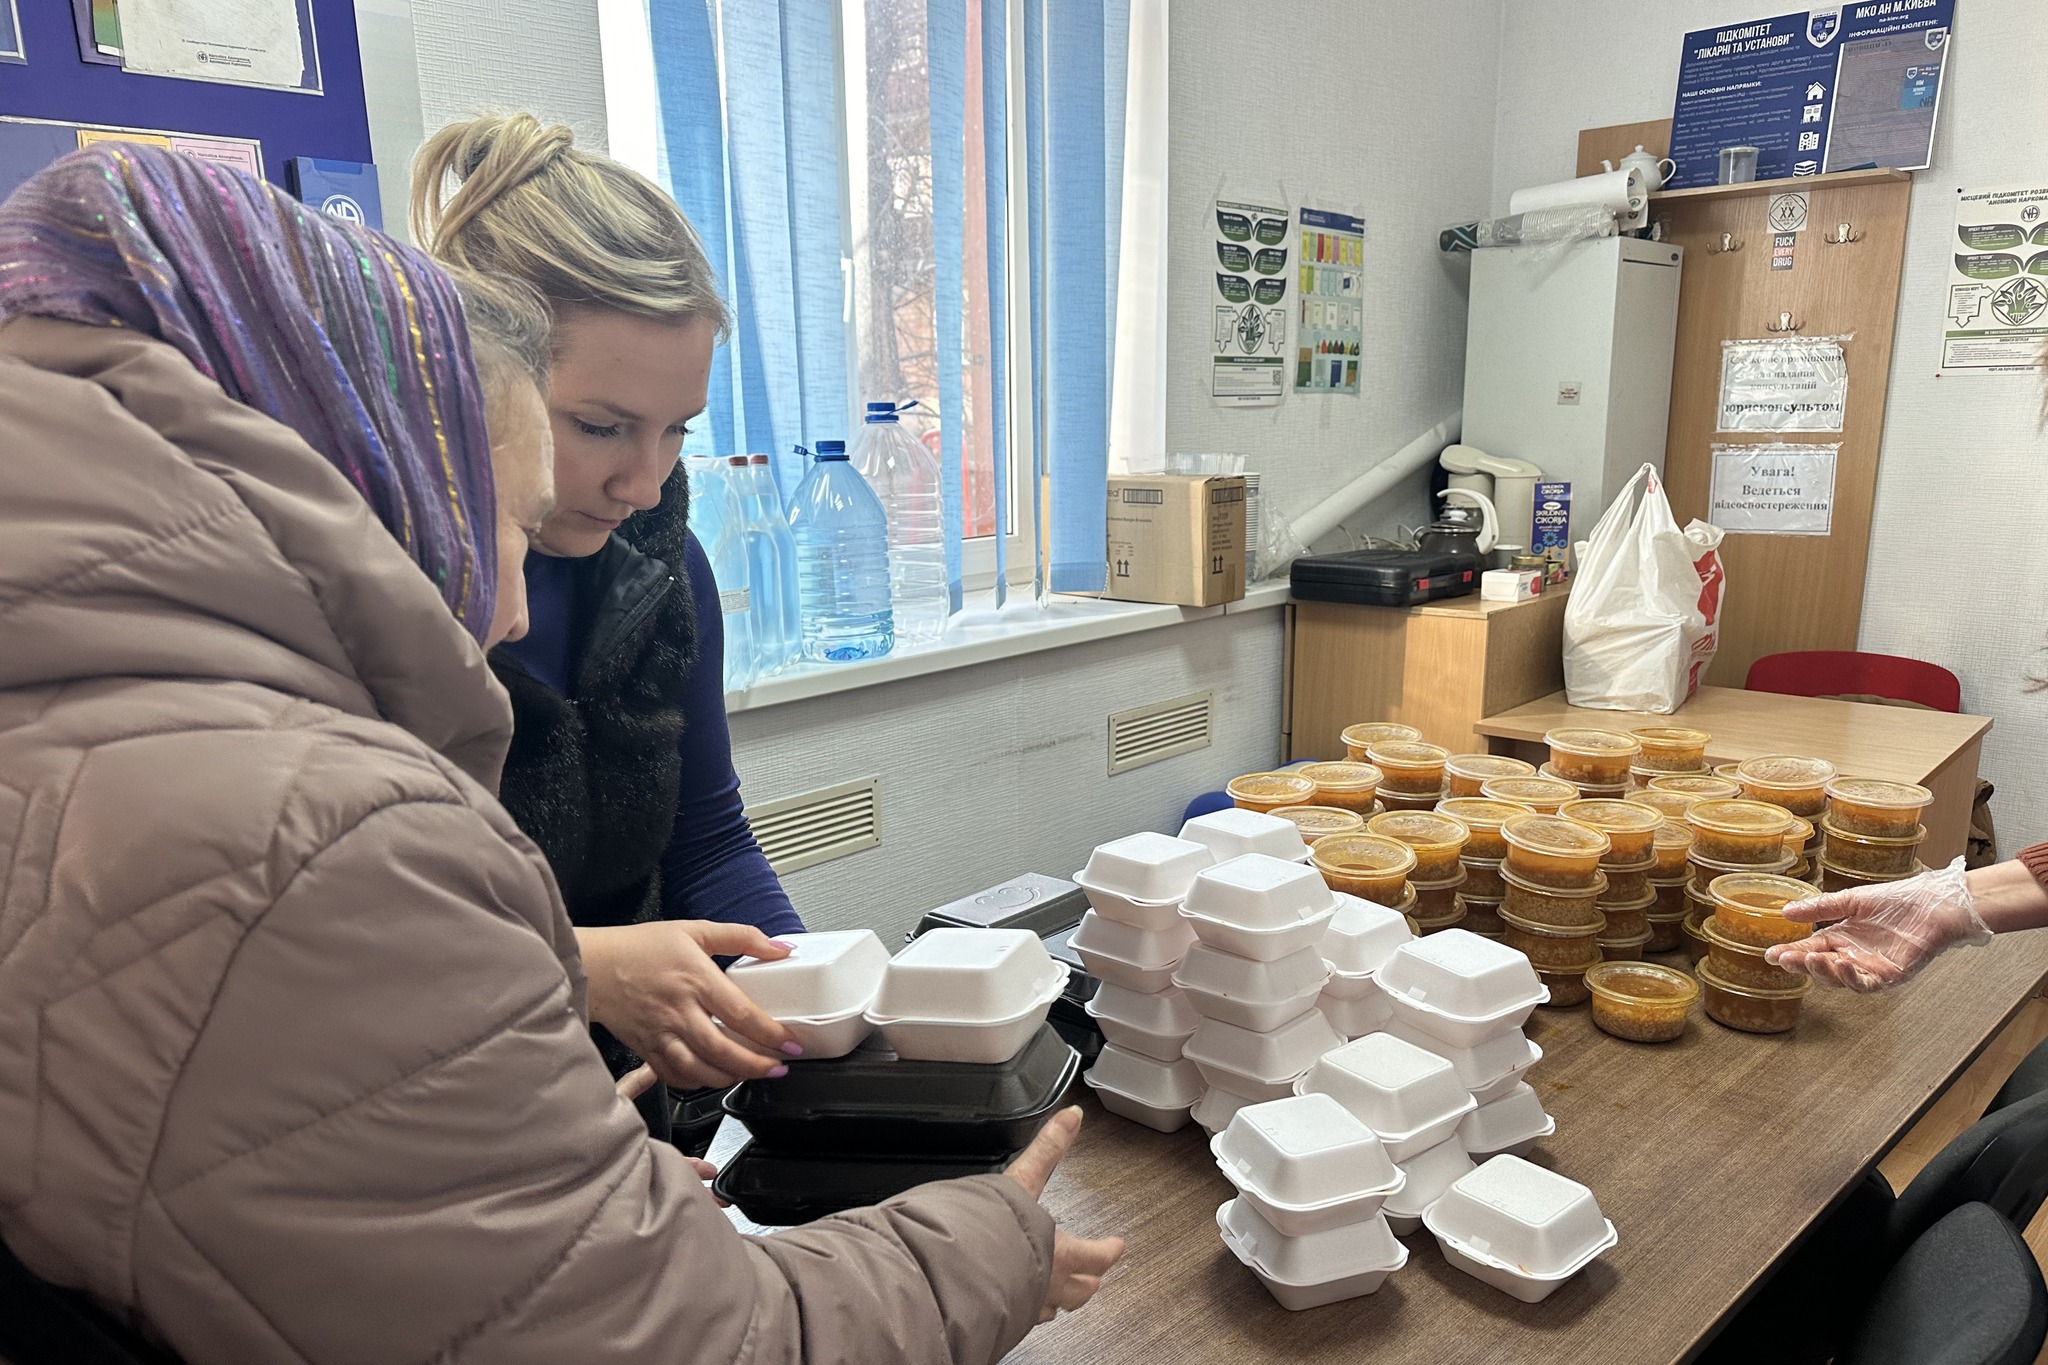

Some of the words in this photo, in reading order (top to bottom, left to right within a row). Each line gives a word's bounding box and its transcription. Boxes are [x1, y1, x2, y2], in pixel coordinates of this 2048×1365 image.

[1855, 6, 1877, 19] МКО
[1877, 4, 1892, 15] АН
[1716, 23, 1772, 43] ПІДКОМІТЕТ
[1848, 25, 1901, 38] ІНФОРМАЦІЙНІ
[1901, 19, 1939, 30] БЮЛЕТЕНІ:
[1694, 44, 1731, 60] "ЛІКАРНІ
[1731, 43, 1743, 54] ТА
[1744, 33, 1795, 52] УСТАНОВИ"
[1682, 88, 1698, 98] НАШІ
[1699, 84, 1725, 96] ОСНОВНІ
[1726, 81, 1763, 93] НАПРЯМКИ:
[1960, 191, 1991, 201] МІСЦЕВИЙ
[1992, 189, 2029, 199] ПІДКОМІТЕТ
[1775, 236, 1795, 247] FUCK
[1774, 246, 1794, 256] EVERY
[1773, 257, 1793, 267] DRUG
[1725, 402, 1840, 415] юрисконсультом
[1751, 466, 1795, 477] Увага!
[1742, 484, 1801, 496] Ведеться
[1714, 499, 1828, 512] відеоспостереження
[1535, 517, 1567, 525] CIKORIJA
